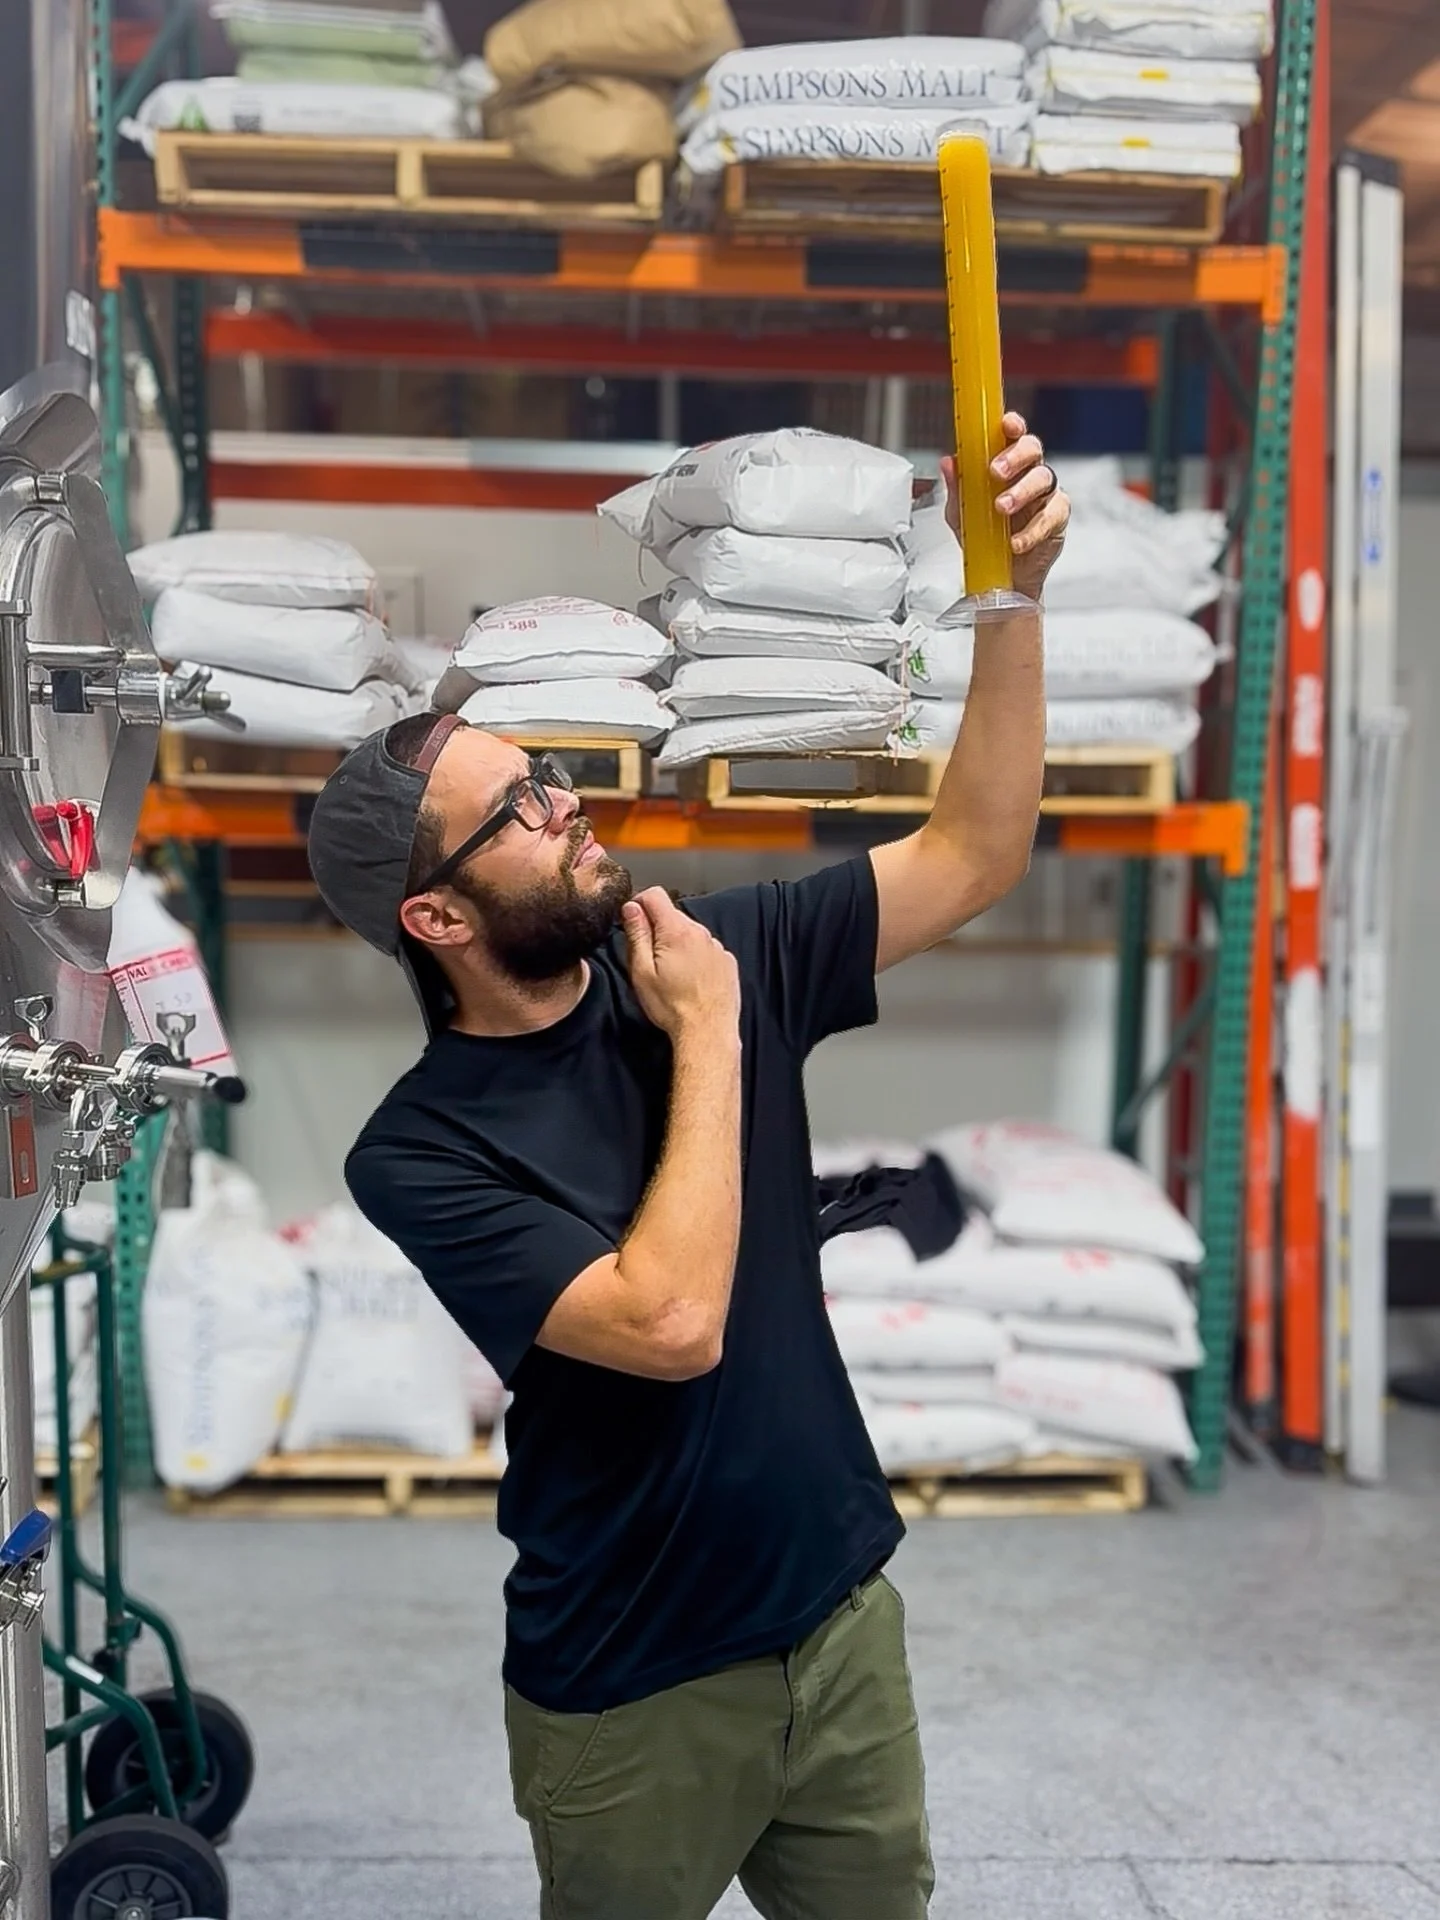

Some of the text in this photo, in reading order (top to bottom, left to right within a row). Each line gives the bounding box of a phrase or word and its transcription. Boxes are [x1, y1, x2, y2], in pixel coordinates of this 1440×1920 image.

[719, 68, 995, 109] SIMPSONS MALT
[742, 126, 1012, 158] SIMPSONS MT
